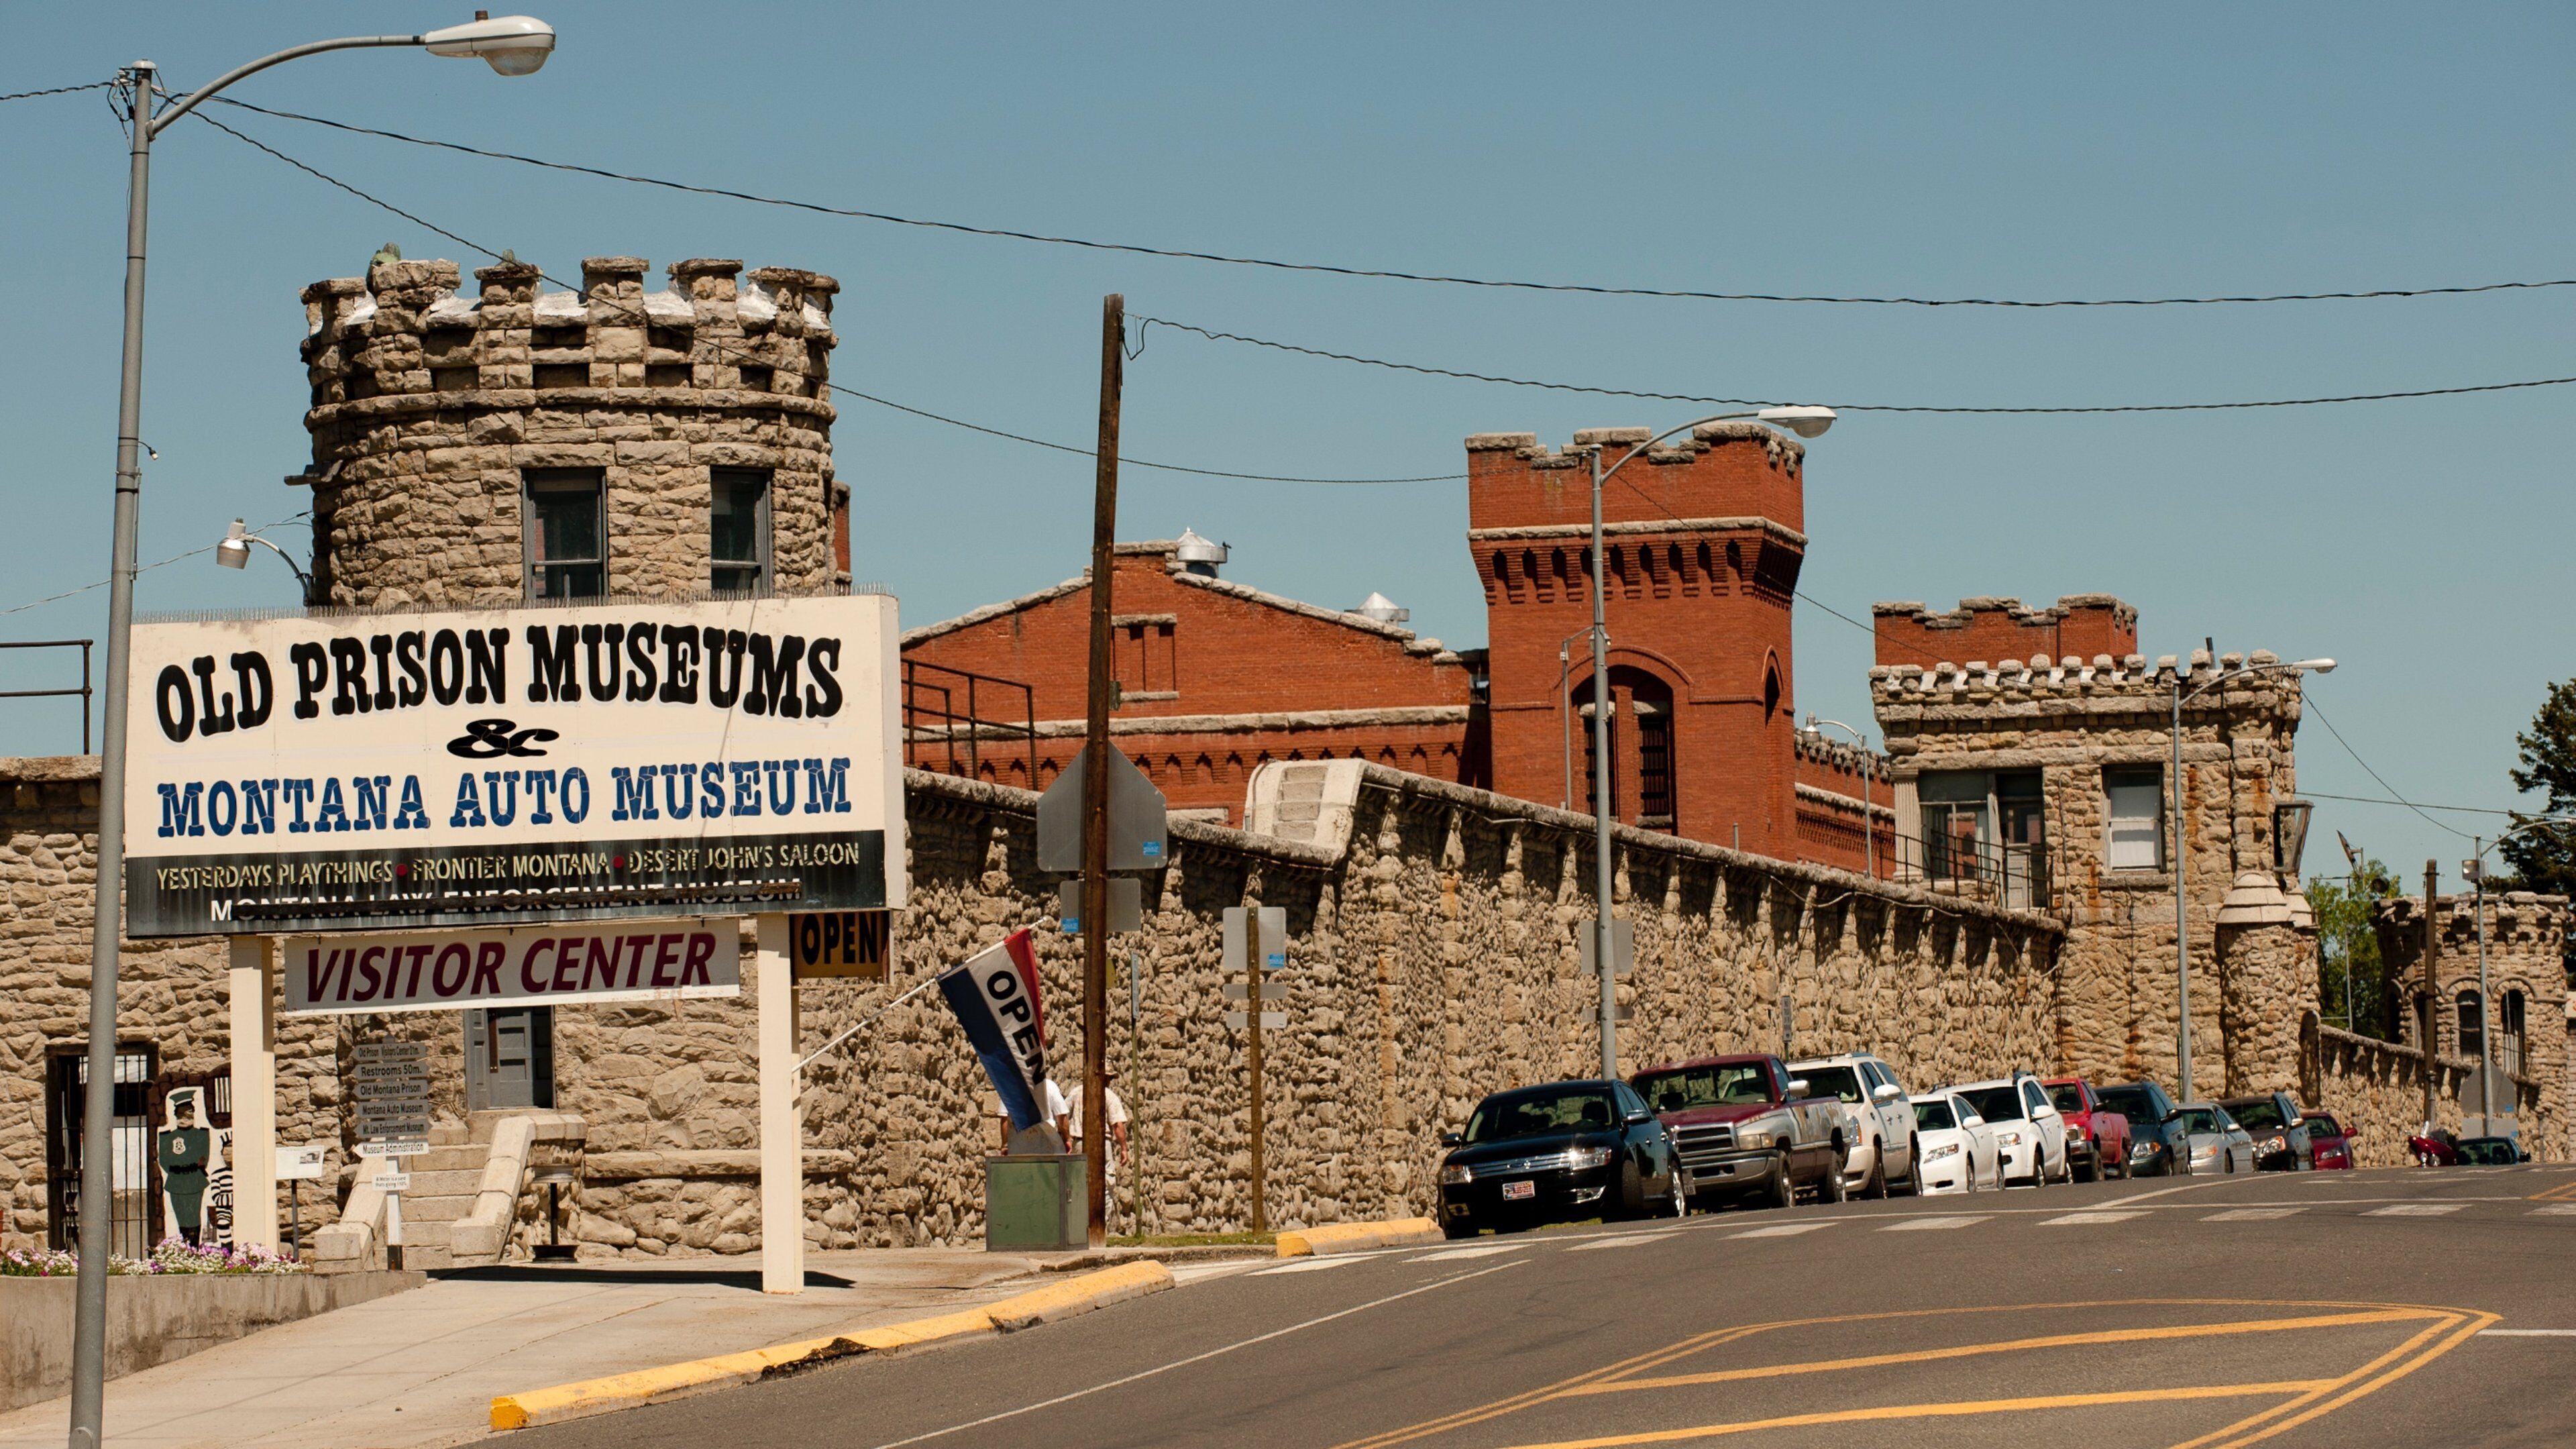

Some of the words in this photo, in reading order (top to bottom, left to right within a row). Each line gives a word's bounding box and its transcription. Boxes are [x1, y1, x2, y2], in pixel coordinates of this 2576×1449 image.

[157, 651, 273, 743] OLD
[290, 627, 510, 719] PRISON
[526, 622, 842, 718] MUSEUMS
[158, 775, 431, 837] MONTANA
[449, 767, 590, 827] AUTO
[611, 757, 851, 822] MUSEUM
[157, 865, 272, 890] YESTERDAYS
[278, 860, 392, 885] PLAYTHINGS
[413, 855, 506, 881] FRONTIER
[513, 853, 610, 877] MONTANA
[629, 848, 699, 873] DESERT
[704, 846, 773, 870] JOHN'S
[780, 843, 859, 867] SALOON
[801, 911, 877, 965] OPEN
[307, 942, 505, 1002] VISITOR
[521, 932, 716, 994] CENTER
[987, 971, 1046, 1085] OPEN
[361, 1066, 402, 1077] Restrooms
[404, 1064, 422, 1074] 50m.
[361, 1085, 371, 1095] Old
[373, 1085, 400, 1095] Montana
[401, 1083, 421, 1093] Prison
[363, 1104, 386, 1115] Montana
[387, 1104, 399, 1114] Auto
[400, 1102, 423, 1114] Museum
[380, 1123, 406, 1134] Enforcement
[407, 1122, 424, 1132] Museum
[363, 1144, 384, 1155] Museum
[386, 1142, 423, 1153] Administration
